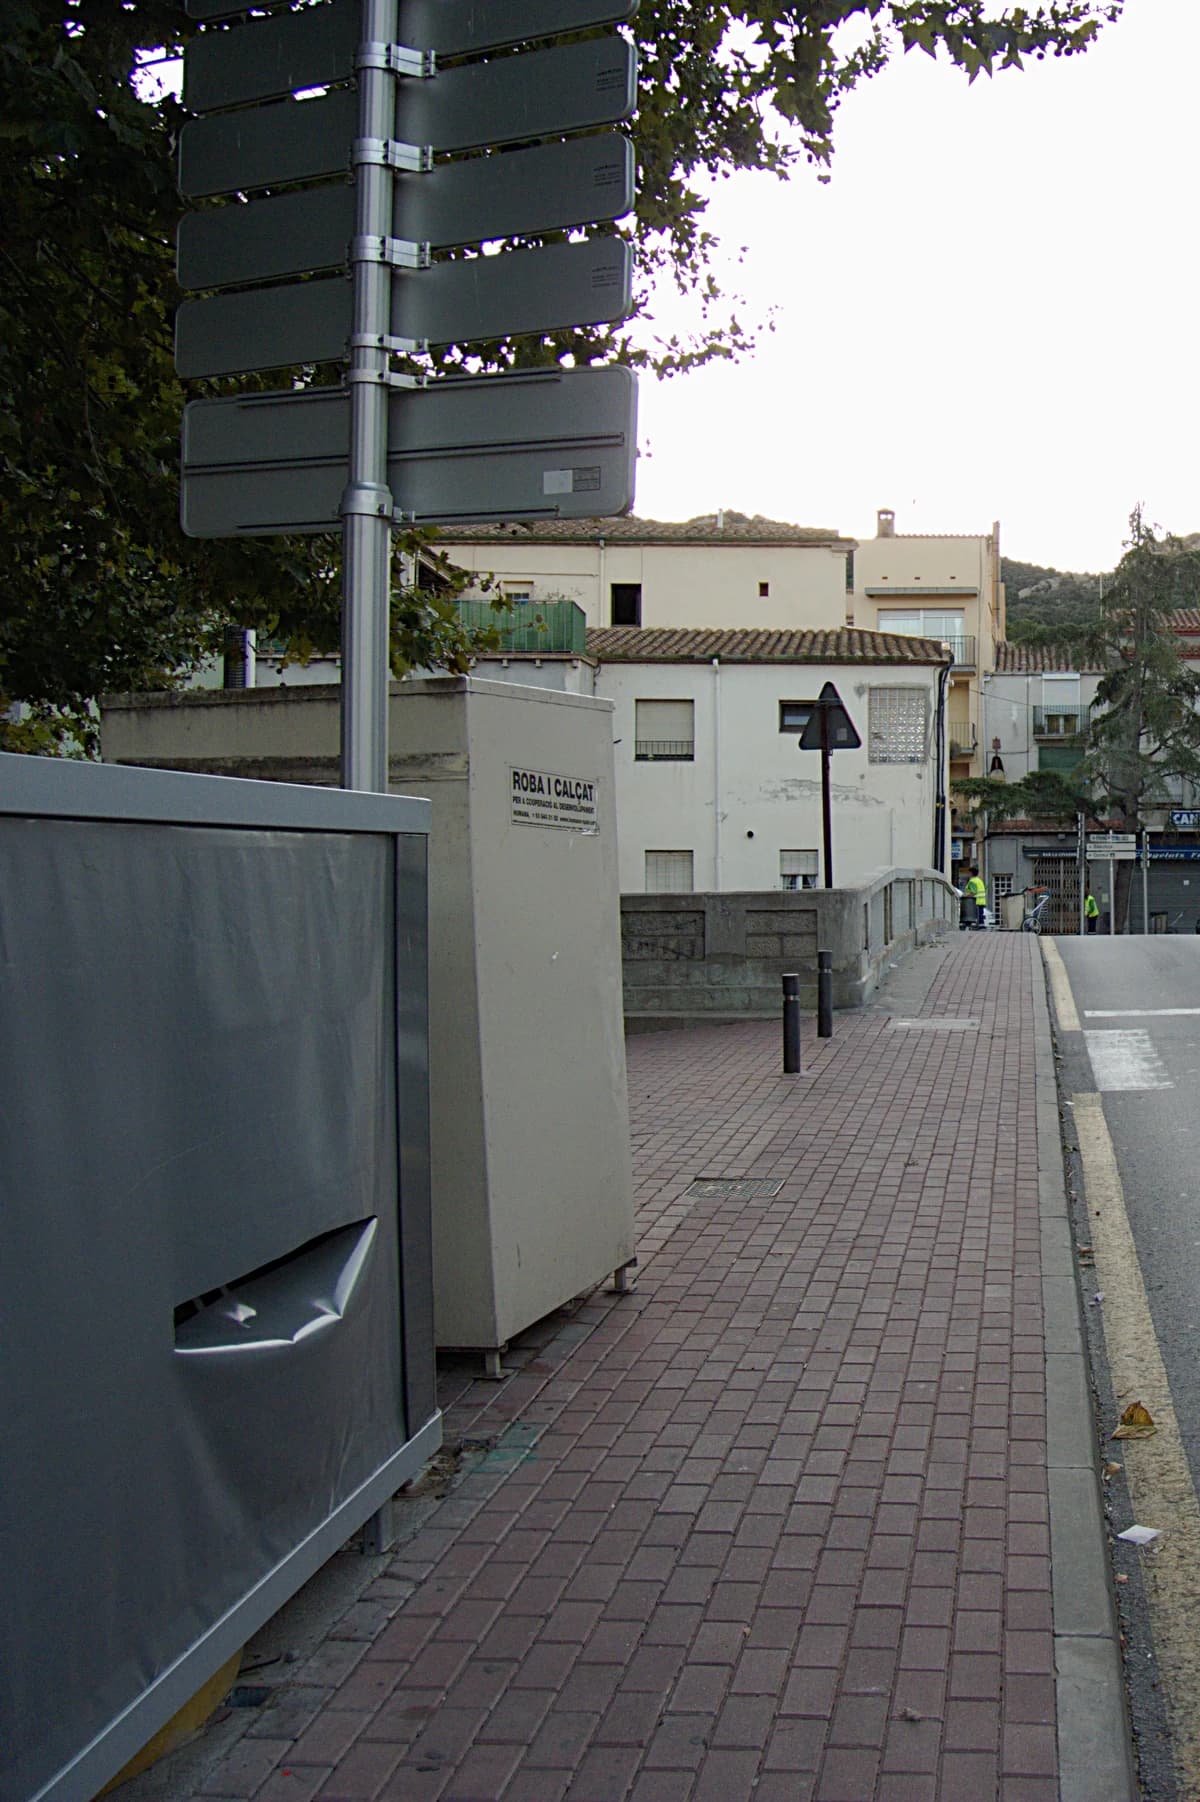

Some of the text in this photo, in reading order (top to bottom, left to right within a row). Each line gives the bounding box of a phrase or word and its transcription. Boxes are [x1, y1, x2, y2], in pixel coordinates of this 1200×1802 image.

[513, 771, 594, 805] ROBA I CALÇAT
